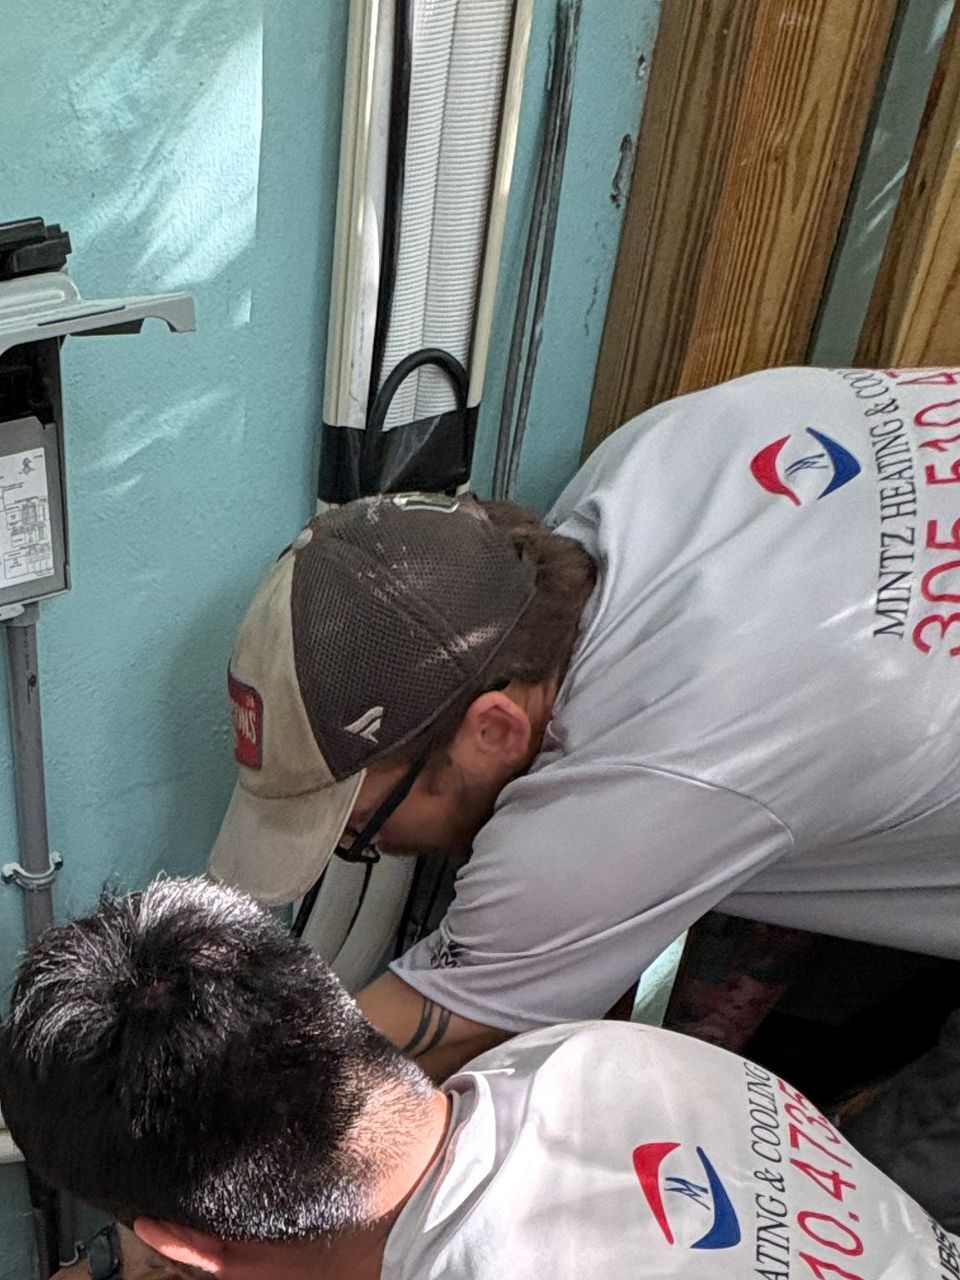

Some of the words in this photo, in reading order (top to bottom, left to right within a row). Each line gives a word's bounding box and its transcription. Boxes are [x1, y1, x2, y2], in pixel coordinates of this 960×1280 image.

[864, 397, 900, 418] &
[870, 418, 917, 524] HEATING
[872, 526, 917, 639] MINTZ
[743, 1061, 782, 1164] COOLING
[753, 1168, 786, 1194] &
